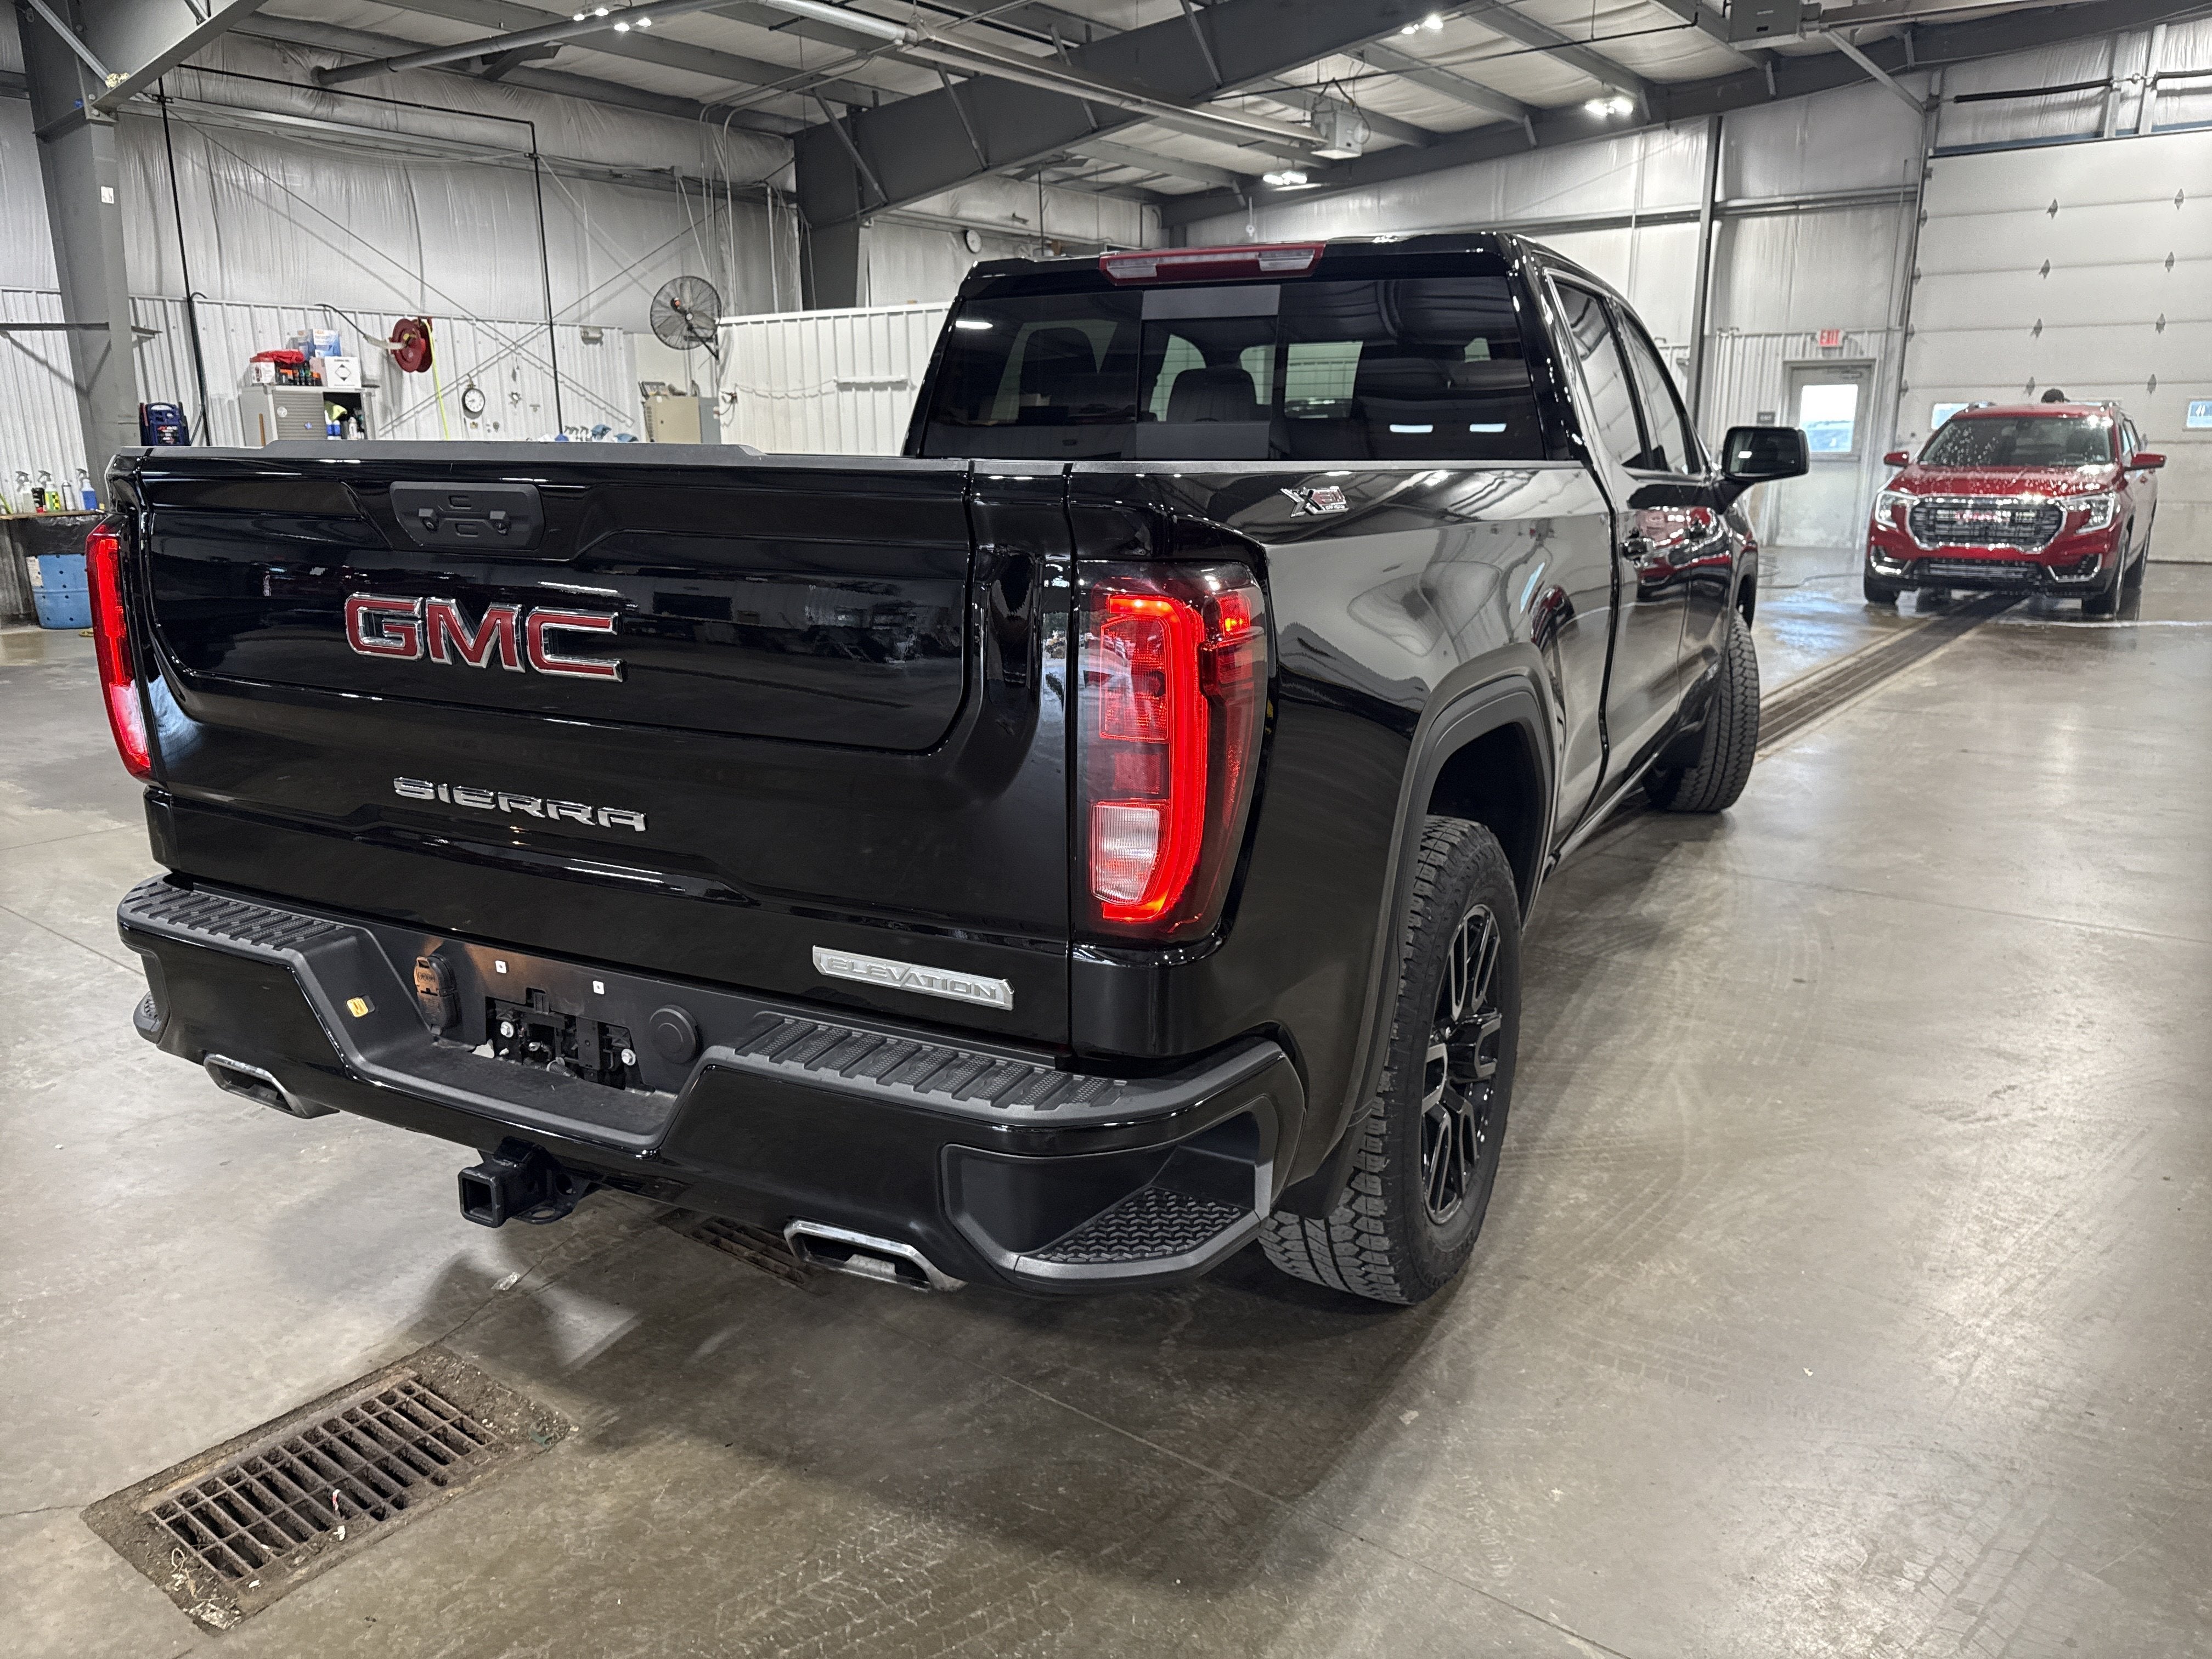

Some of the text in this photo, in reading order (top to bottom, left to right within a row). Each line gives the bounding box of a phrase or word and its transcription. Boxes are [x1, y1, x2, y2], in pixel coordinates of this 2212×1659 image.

[1820, 329, 1839, 346] EXIT
[345, 591, 627, 683] GMC
[393, 776, 648, 832] SIERRA
[826, 955, 997, 1001] ELEVATION
